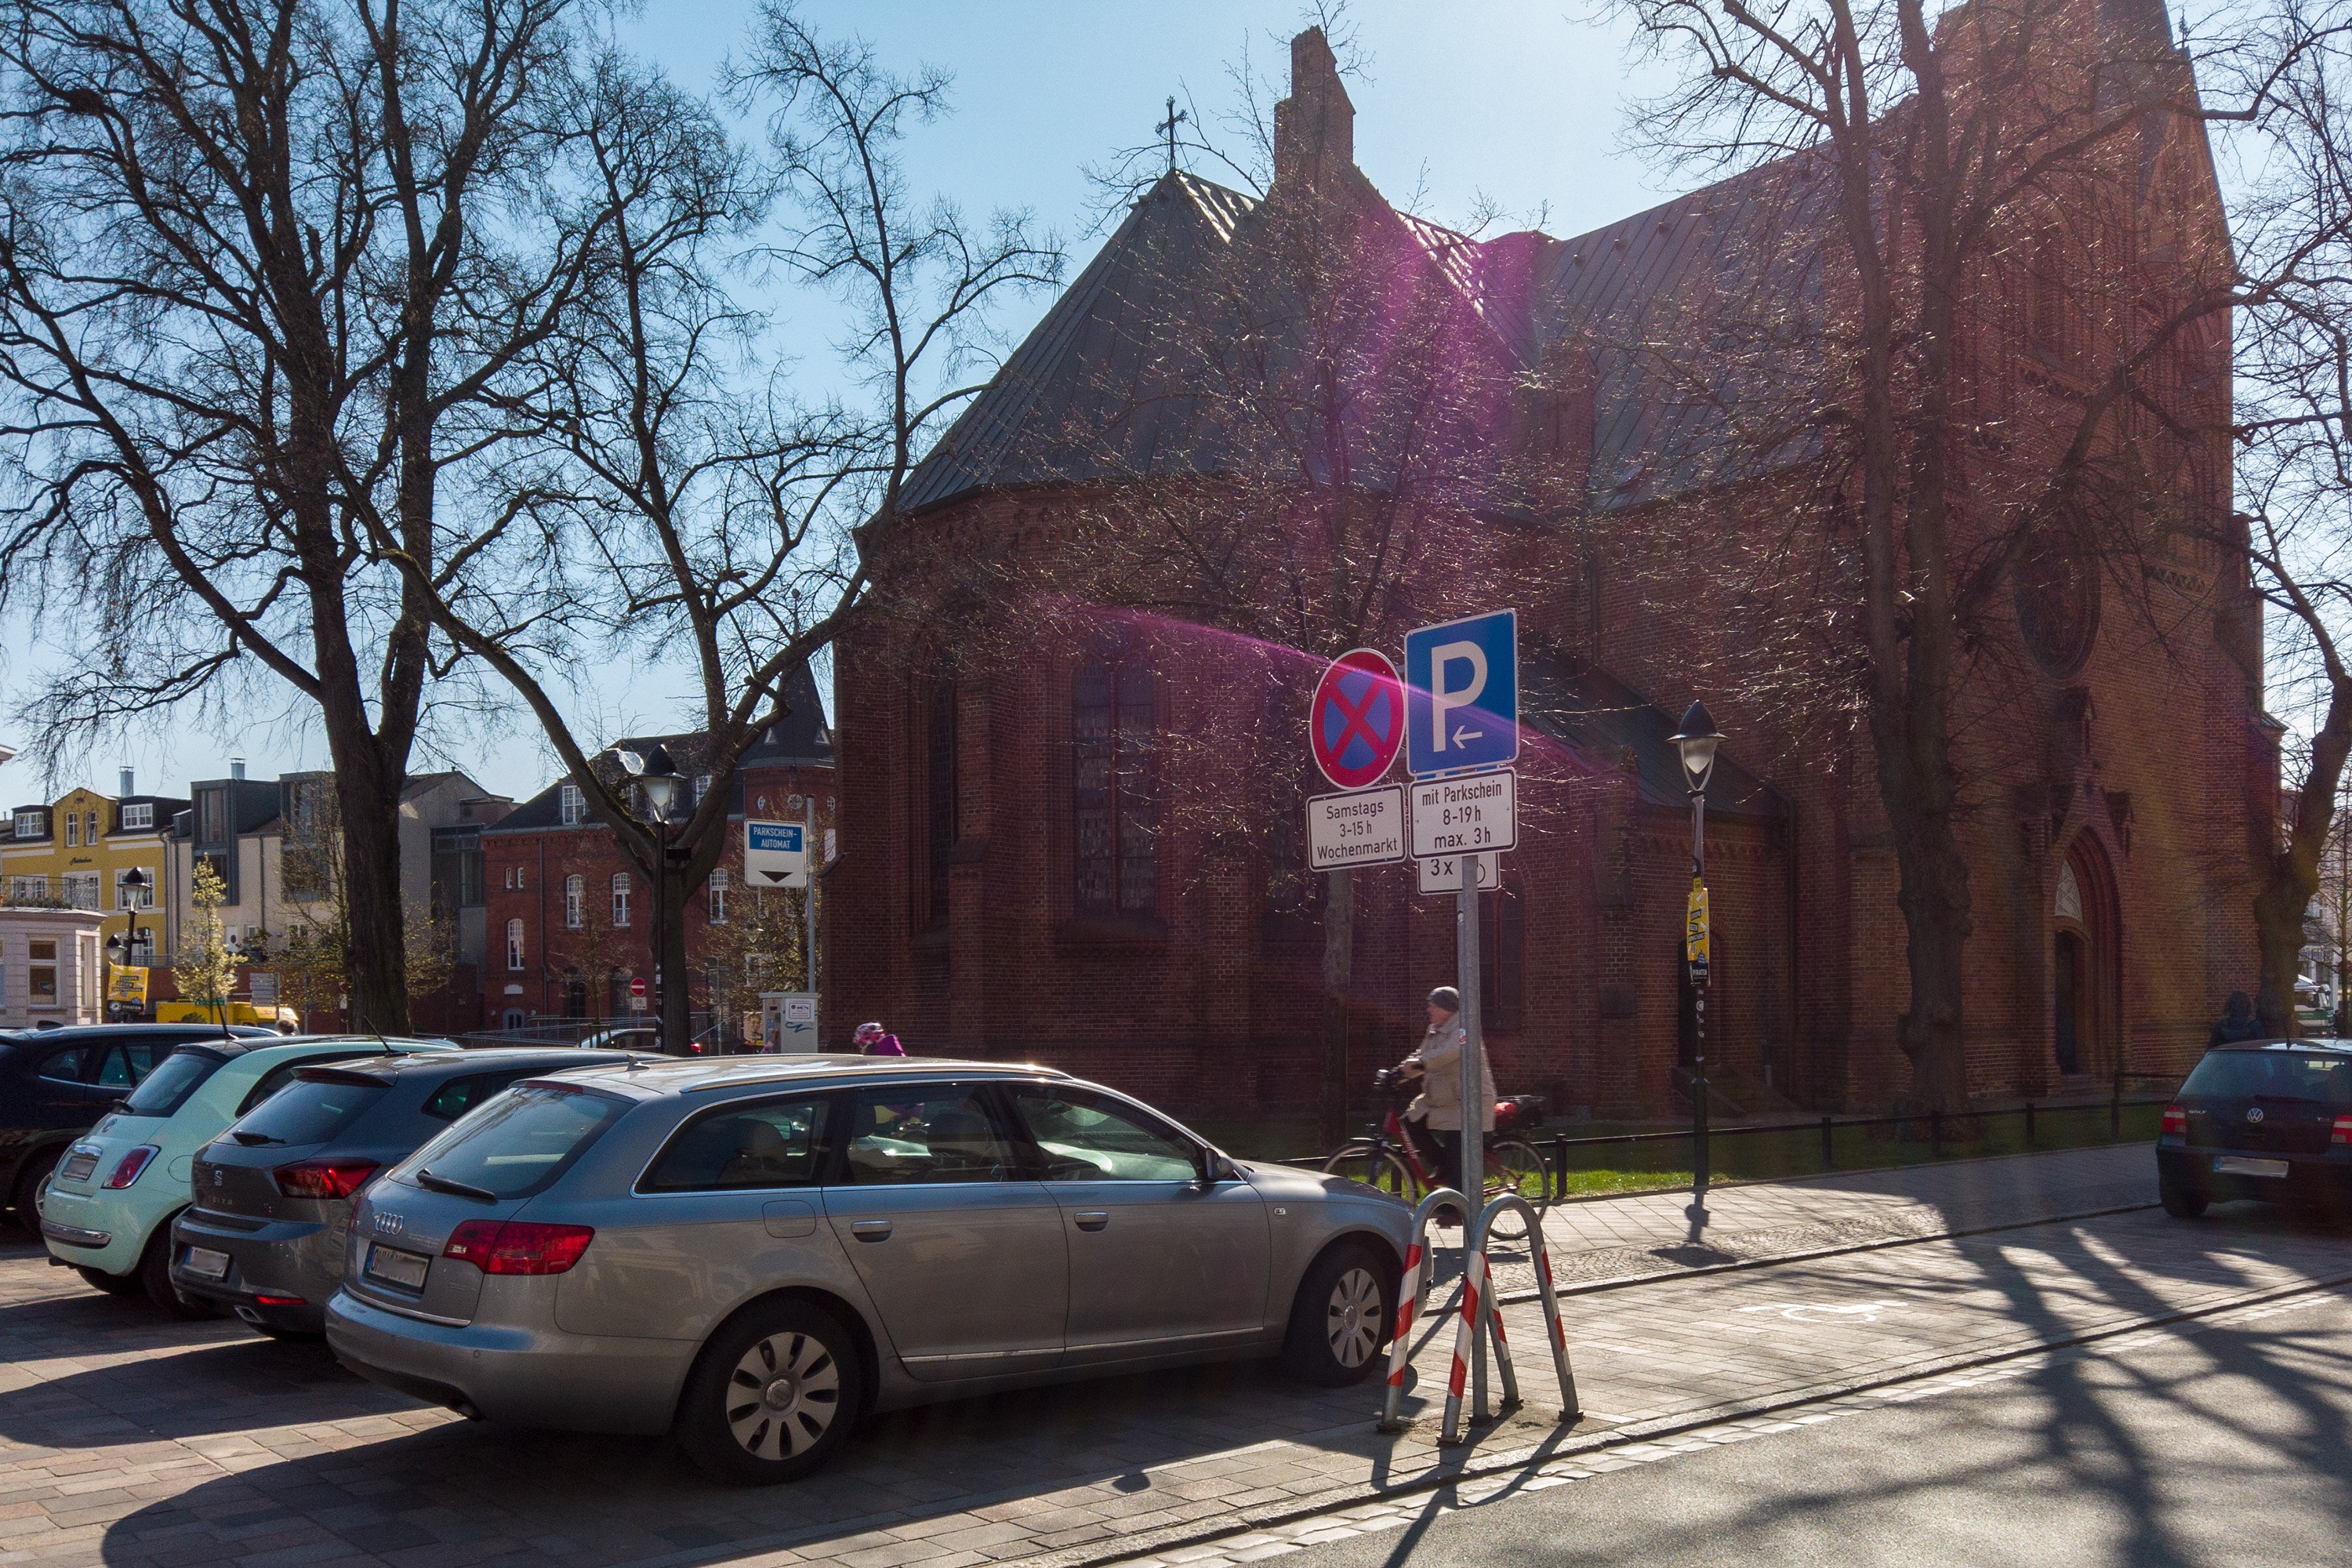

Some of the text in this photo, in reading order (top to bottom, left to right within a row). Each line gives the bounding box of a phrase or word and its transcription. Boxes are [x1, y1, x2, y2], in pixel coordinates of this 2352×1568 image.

[1431, 640, 1488, 753] P
[1421, 780, 1502, 806] mit Parkschein
[1326, 800, 1384, 820] Samstags
[753, 826, 797, 838] PARKSCHEIN-
[1434, 833, 1467, 849] max.
[760, 839, 791, 849] AUTOMAT
[1316, 837, 1398, 860] Wochenmarkt
